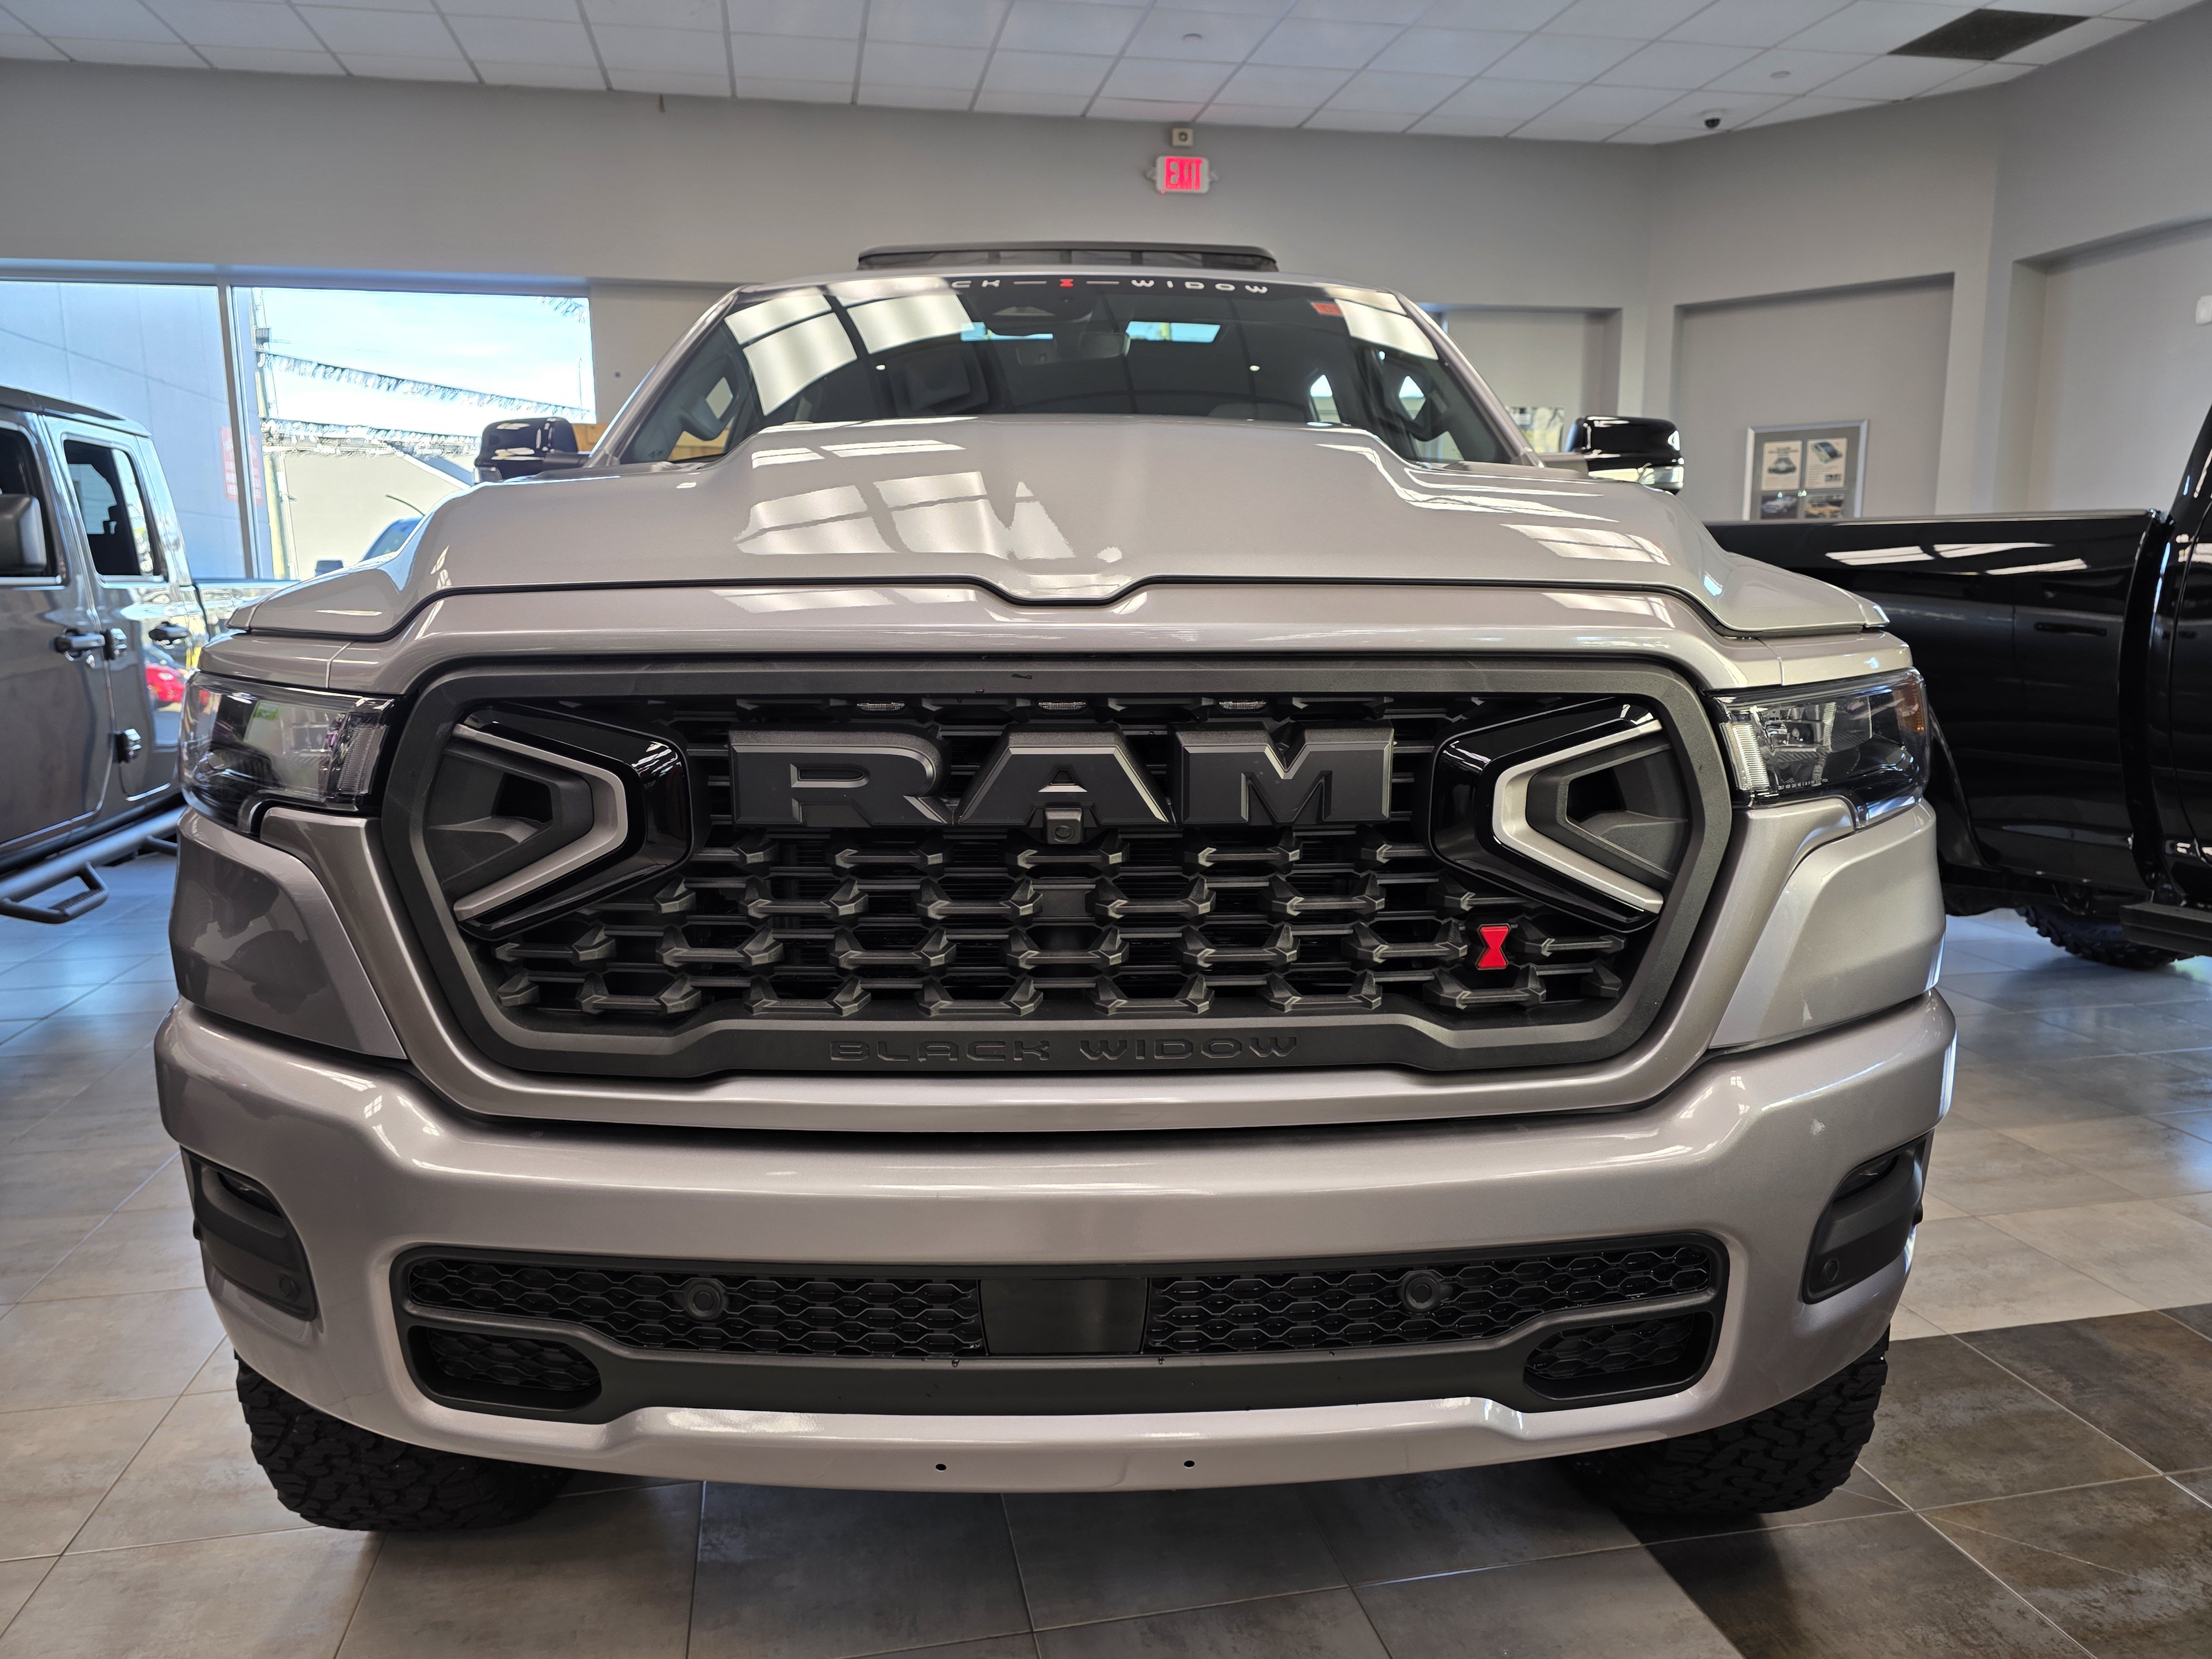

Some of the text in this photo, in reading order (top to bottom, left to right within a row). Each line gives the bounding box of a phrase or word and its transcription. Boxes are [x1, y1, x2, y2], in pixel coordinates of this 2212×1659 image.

[1165, 156, 1203, 190] EXIT
[1131, 280, 1268, 294] WIDOW
[729, 721, 1395, 827] RAM
[830, 1036, 1297, 1061] BLACK WIDOW
